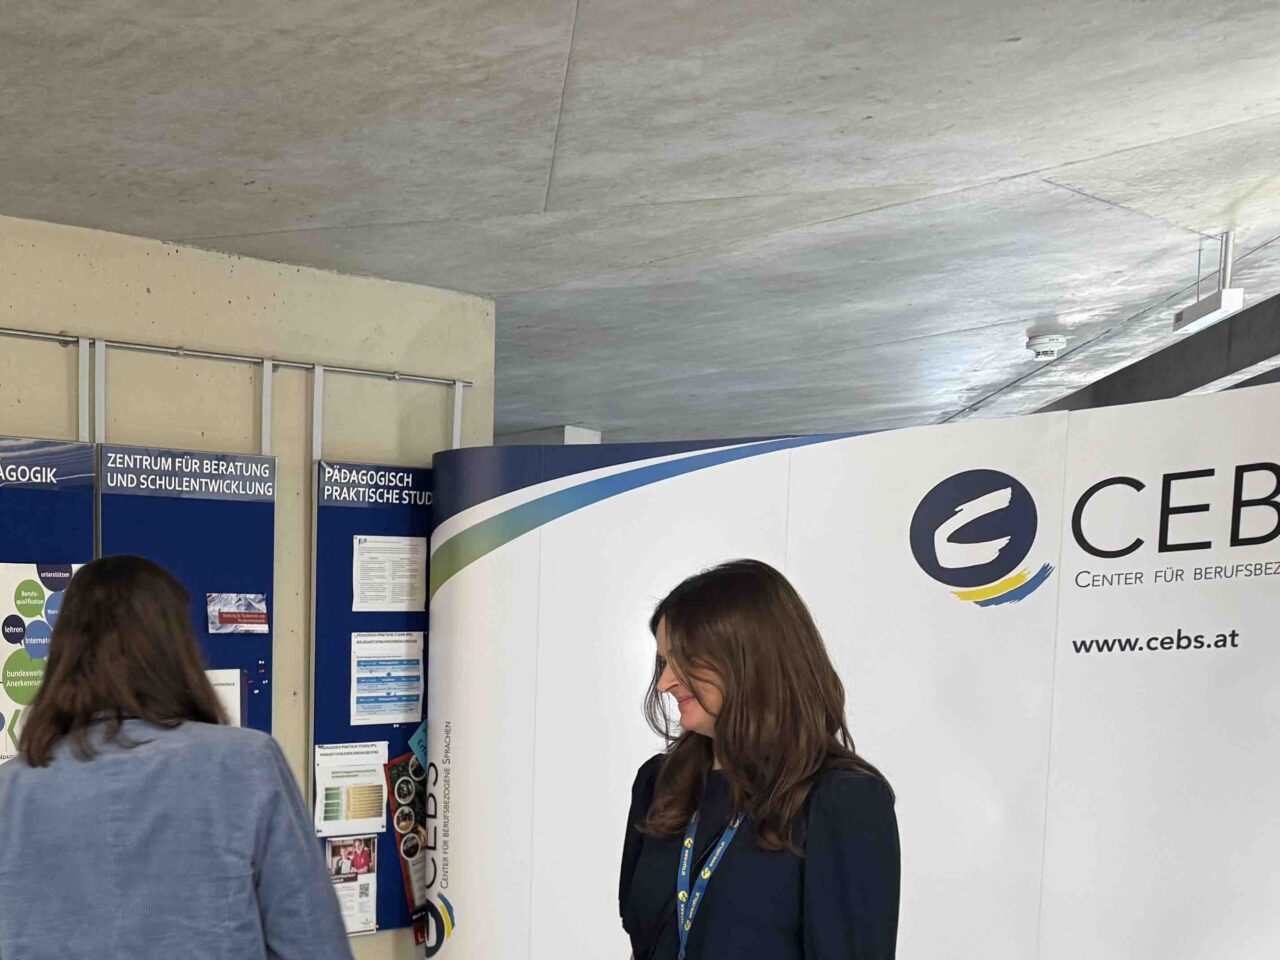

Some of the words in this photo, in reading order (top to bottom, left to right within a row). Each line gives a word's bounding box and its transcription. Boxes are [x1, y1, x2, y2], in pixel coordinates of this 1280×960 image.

[107, 453, 172, 471] ZENTRUM
[175, 455, 200, 473] FÜR
[203, 459, 269, 477] BERATUNG
[325, 466, 412, 488] PÄDAGOGISCH
[107, 472, 137, 488] UND
[139, 474, 273, 496] SCHULENTWICKLUNG
[324, 485, 400, 504] PRAKTISCHE
[1072, 628, 1240, 654] www.cebs.at
